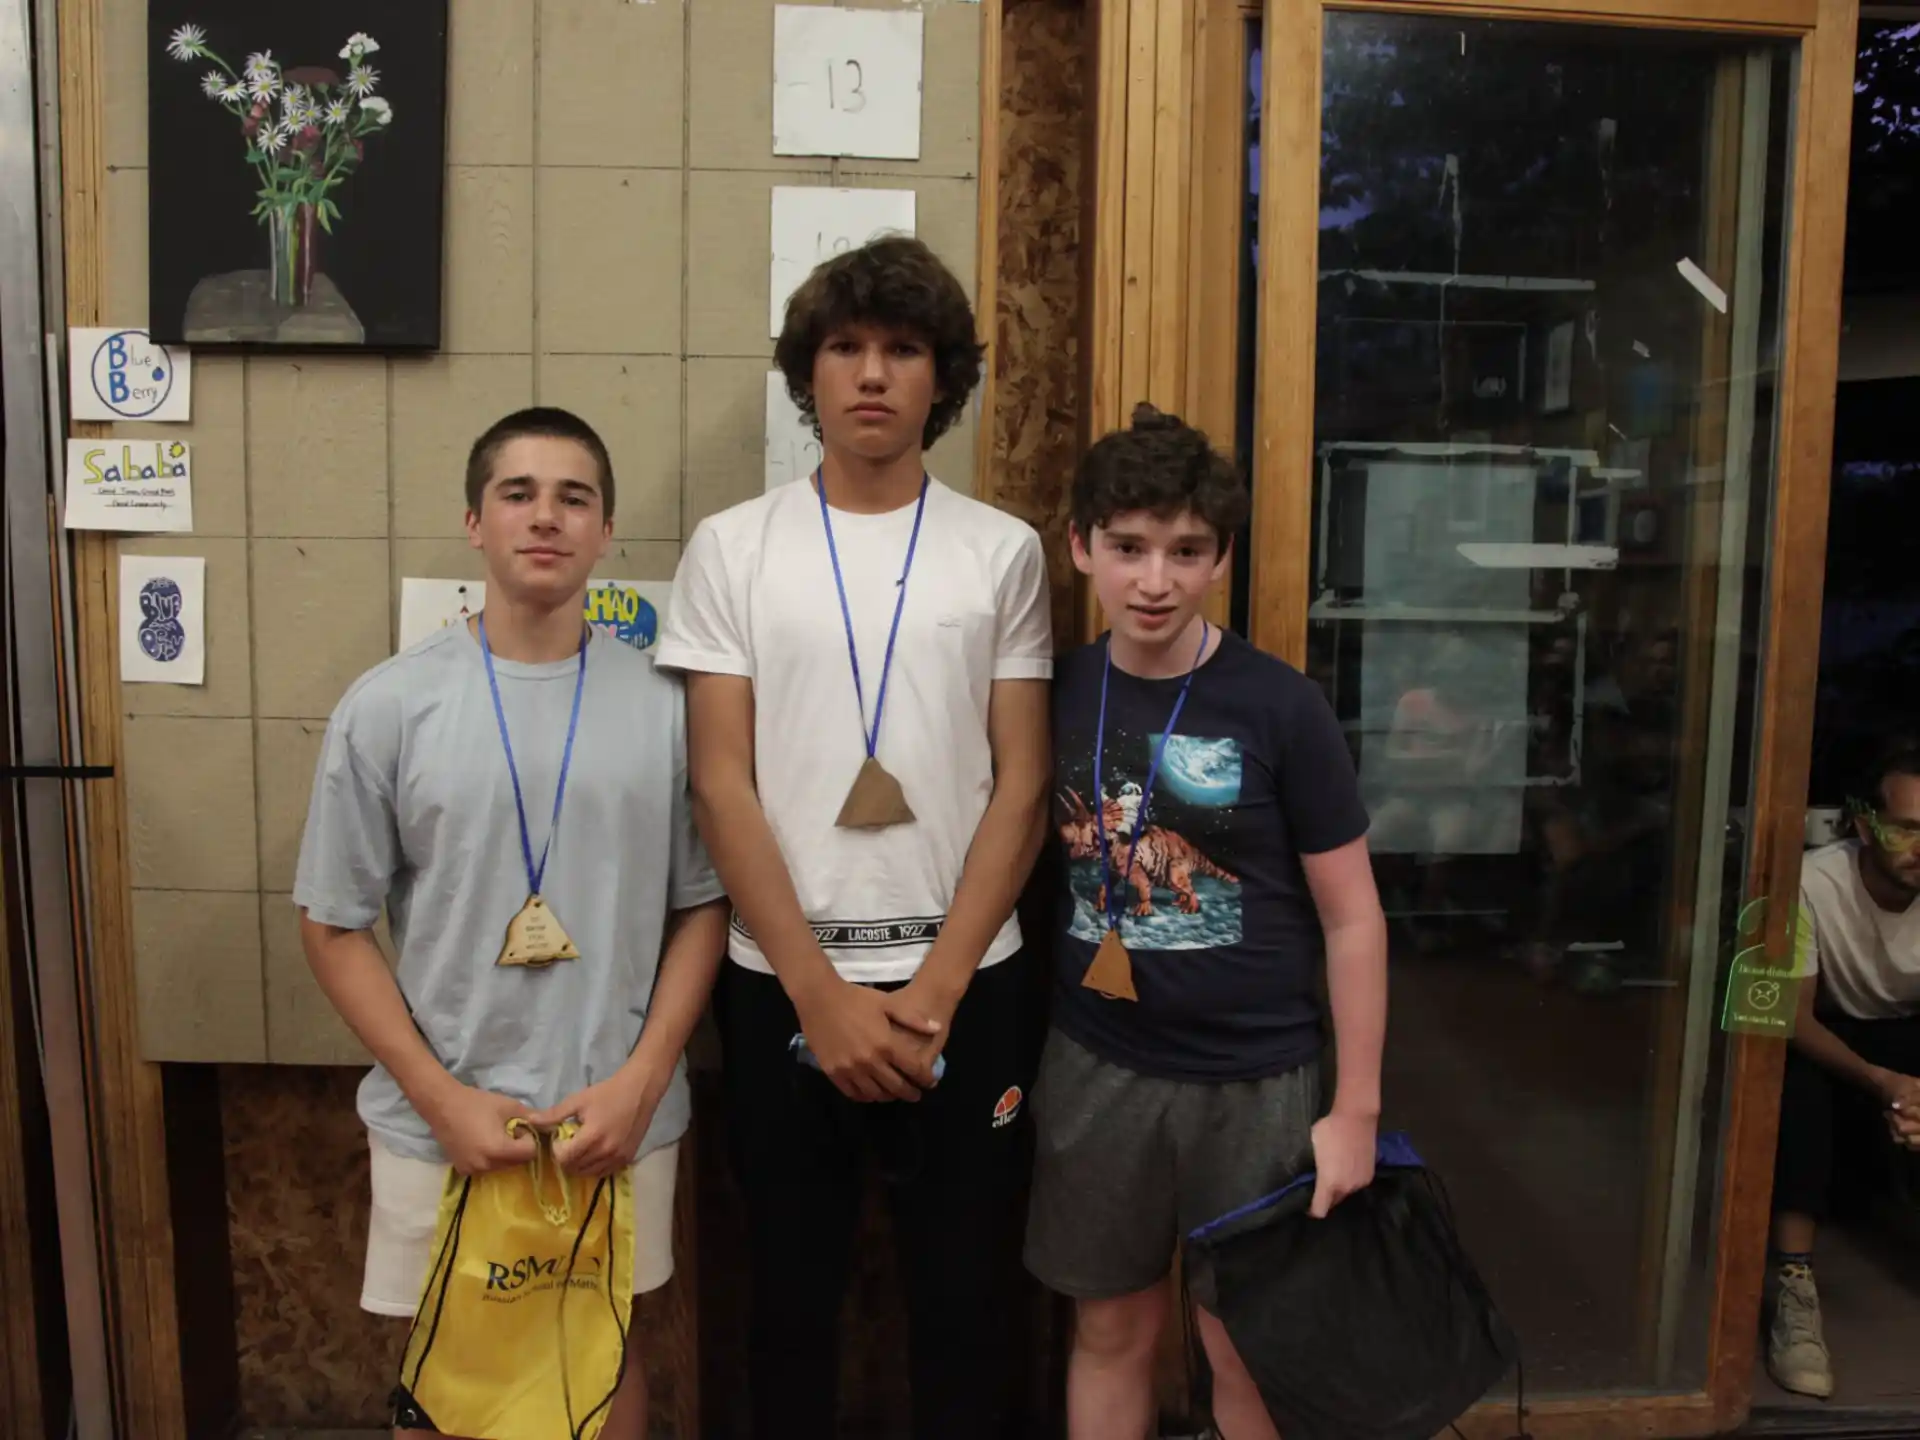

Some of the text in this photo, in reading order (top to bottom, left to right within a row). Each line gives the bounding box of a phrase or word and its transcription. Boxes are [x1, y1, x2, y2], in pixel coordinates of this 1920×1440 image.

[107, 335, 153, 370] Blue
[108, 371, 158, 404] Berry
[83, 442, 187, 485] Sababa
[847, 927, 891, 941] LACOSTE
[898, 924, 928, 938] 1927
[486, 1255, 558, 1291] RSM
